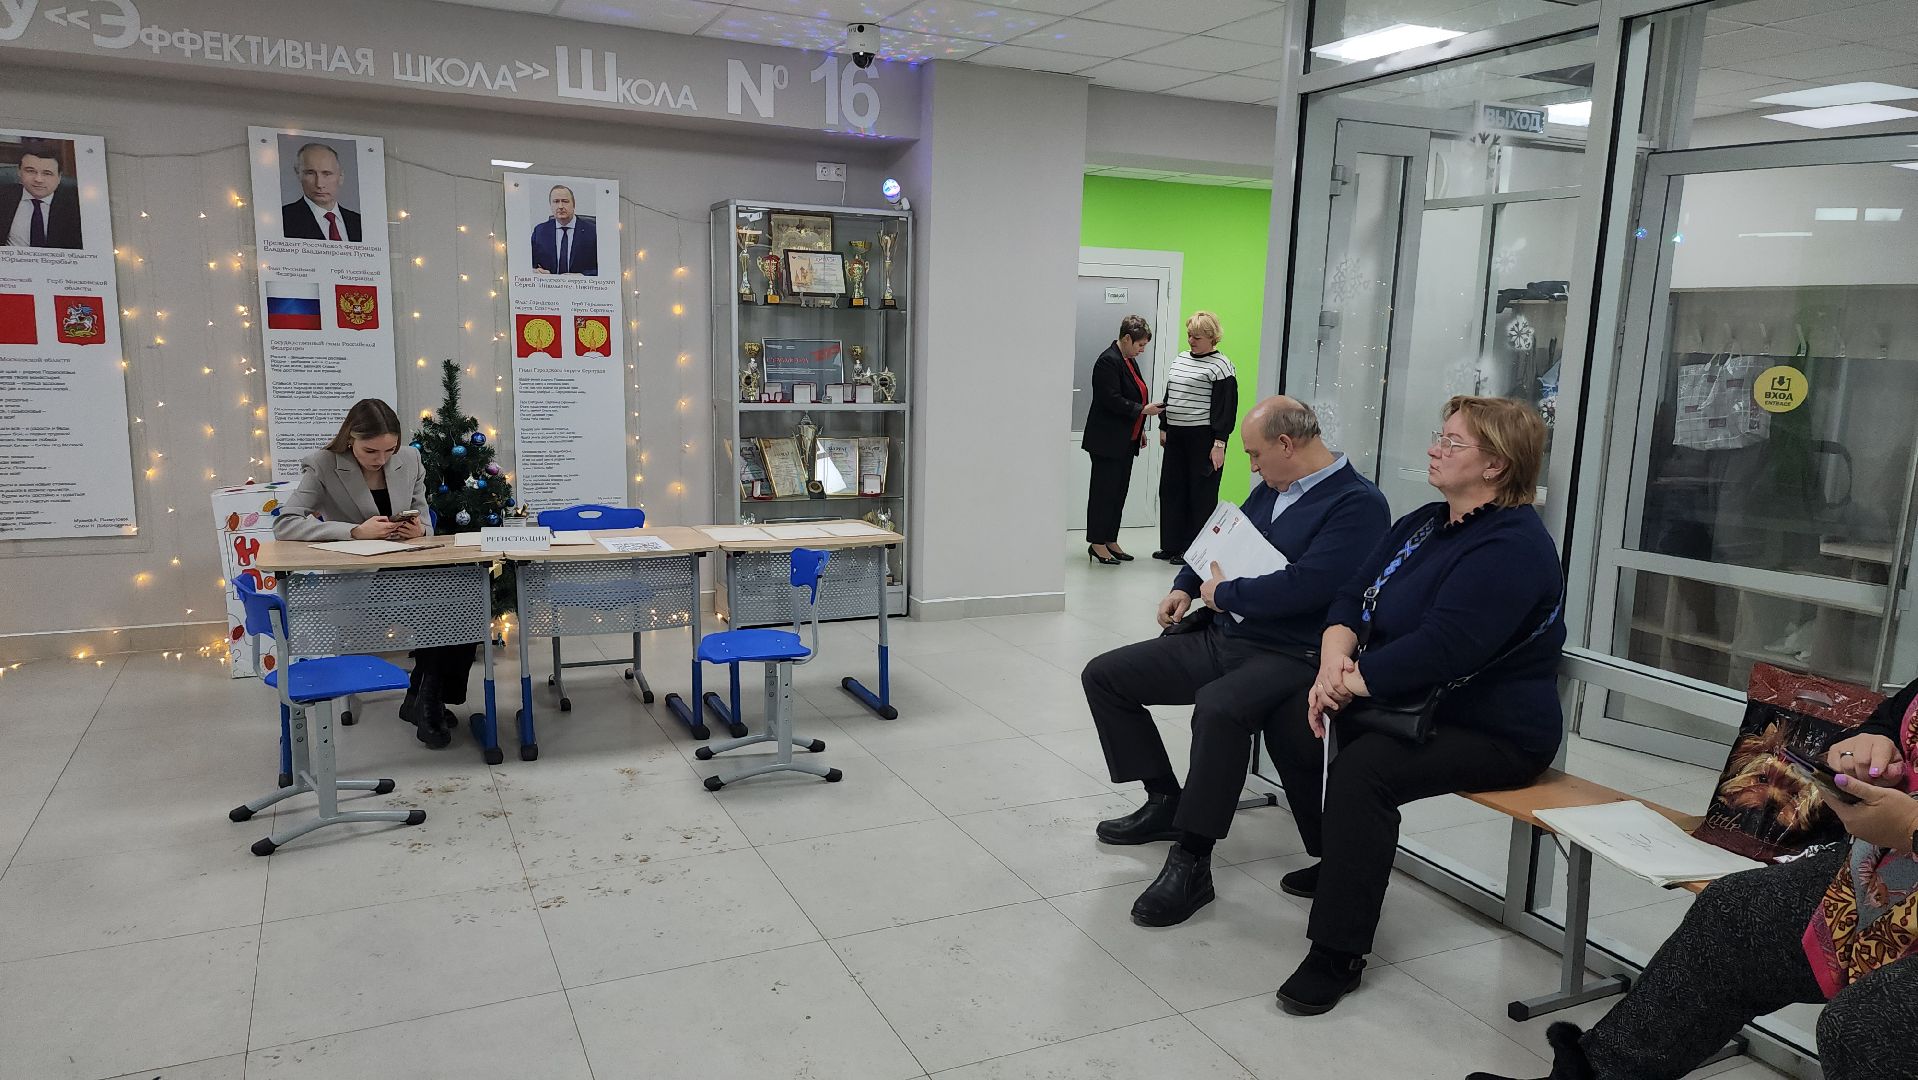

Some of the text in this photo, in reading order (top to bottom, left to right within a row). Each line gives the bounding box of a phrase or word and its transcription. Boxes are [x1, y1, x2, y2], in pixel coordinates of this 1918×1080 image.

[810, 55, 881, 128] 16
[1484, 107, 1541, 132] ВЫХОД
[1764, 391, 1794, 401] ВХОД
[486, 535, 547, 543] РЕГИСТРАЦИЯ
[1704, 802, 1742, 833] Little
